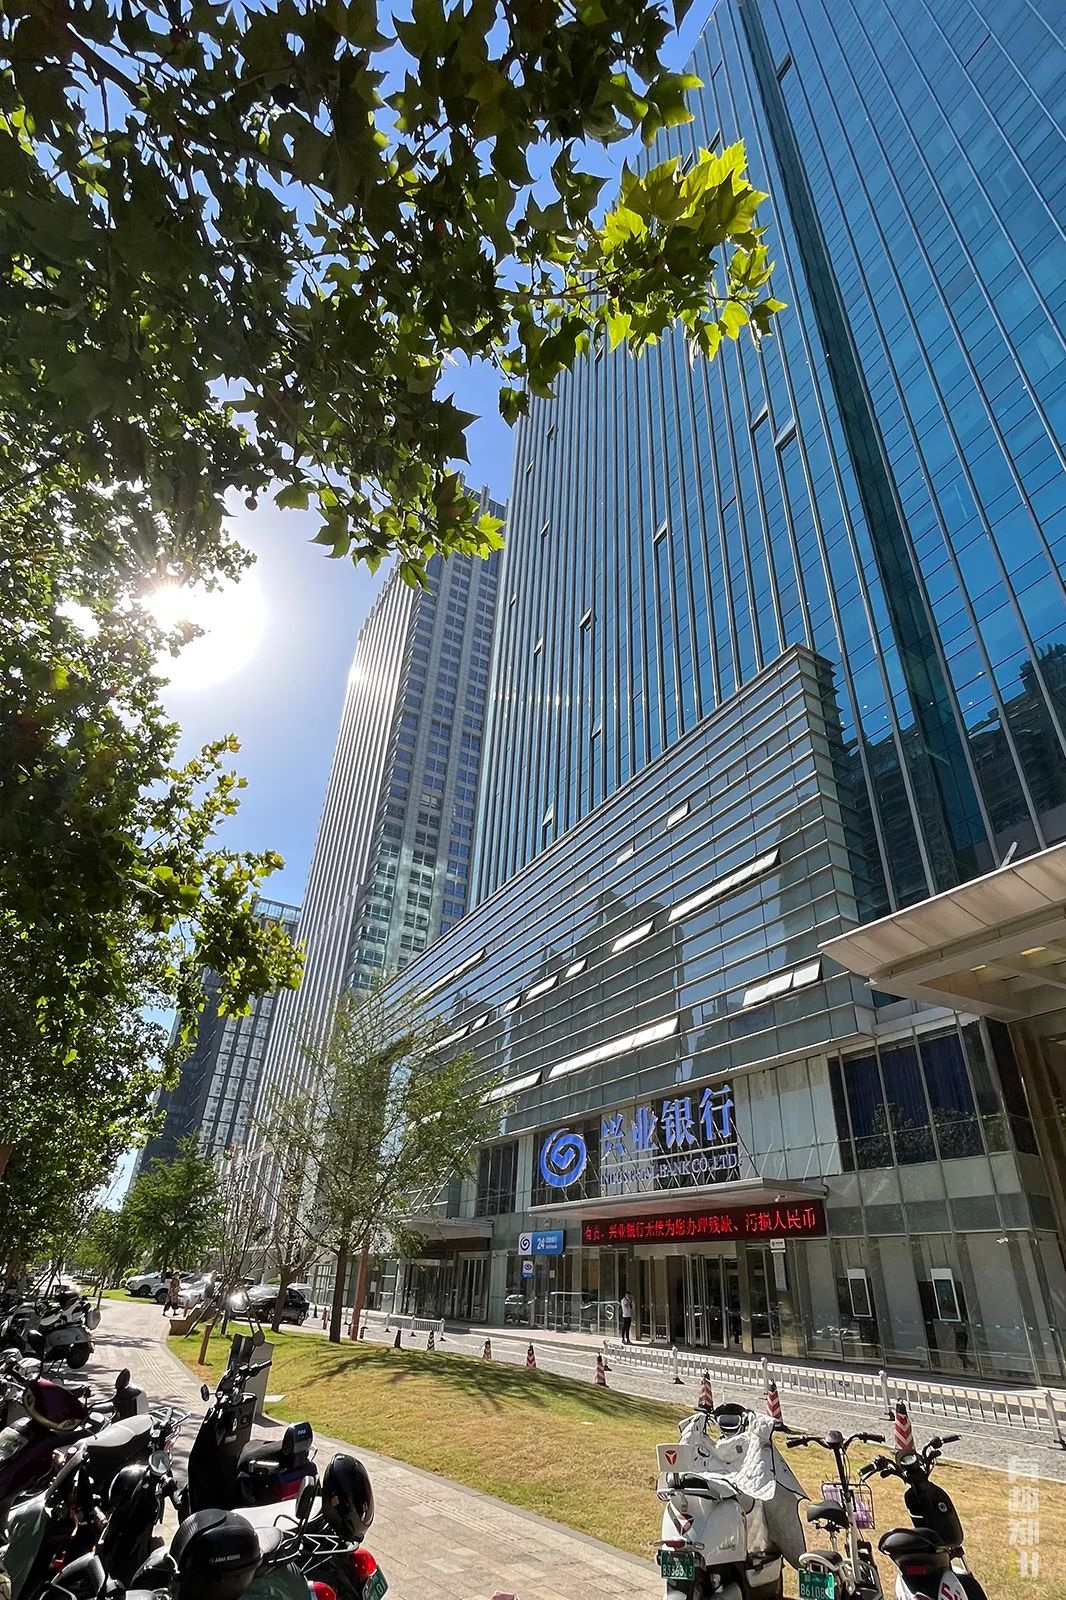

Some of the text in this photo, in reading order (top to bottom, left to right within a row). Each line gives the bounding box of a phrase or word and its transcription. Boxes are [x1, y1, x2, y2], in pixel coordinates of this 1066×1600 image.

[600, 1084, 734, 1160] 兴业银行
[659, 1160, 692, 1178] BANK
[536, 1237, 546, 1250] 24
